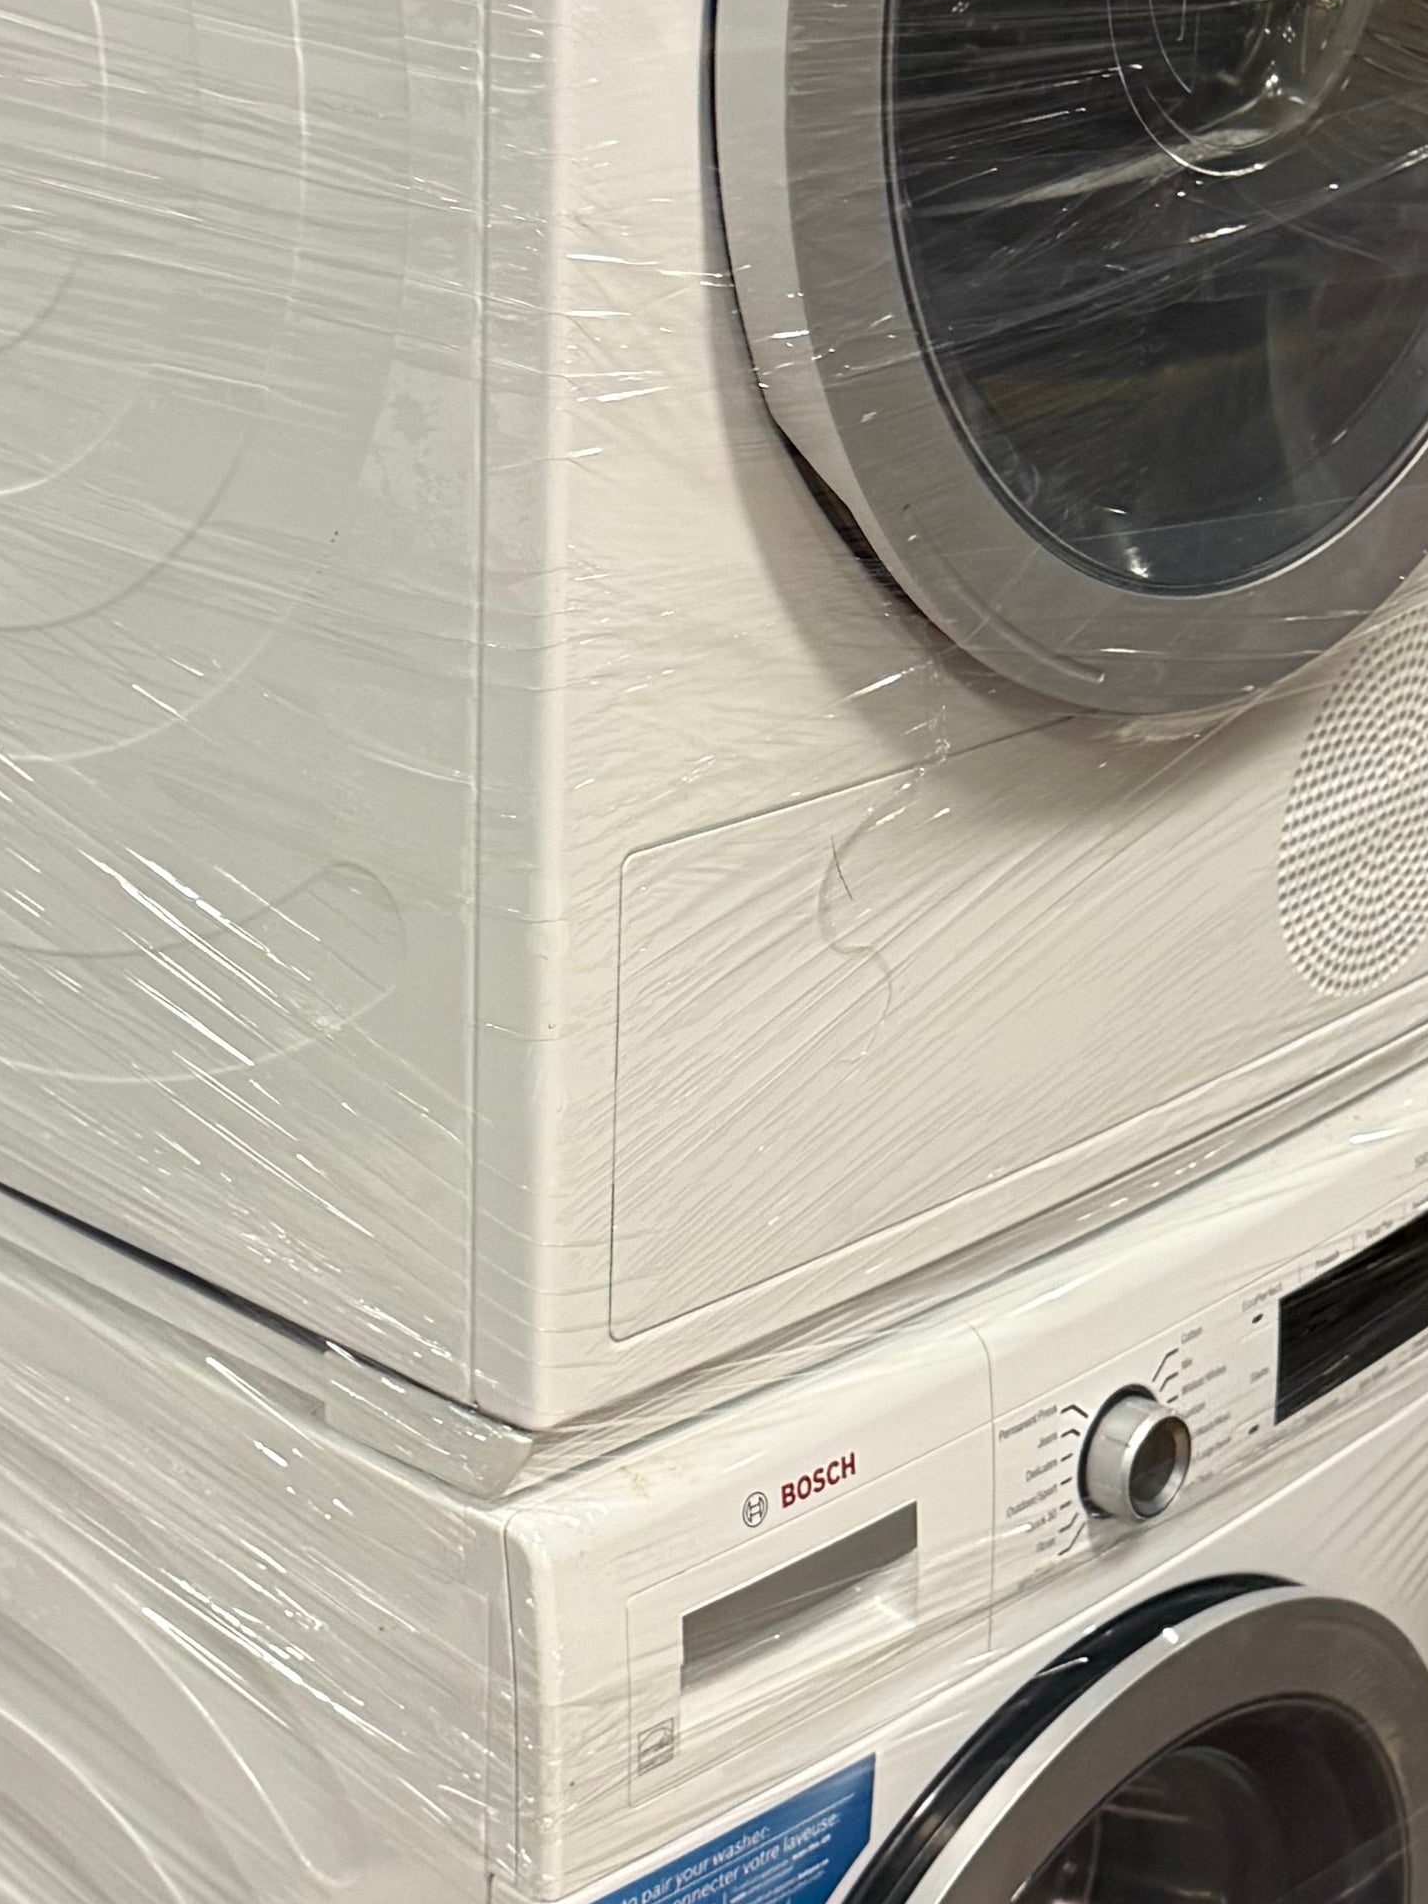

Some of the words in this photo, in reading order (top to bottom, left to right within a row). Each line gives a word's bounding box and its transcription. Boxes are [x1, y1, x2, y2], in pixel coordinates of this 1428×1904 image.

[780, 1450, 857, 1509] BOSCH
[674, 1856, 710, 1893] your
[742, 1845, 781, 1875] votre
